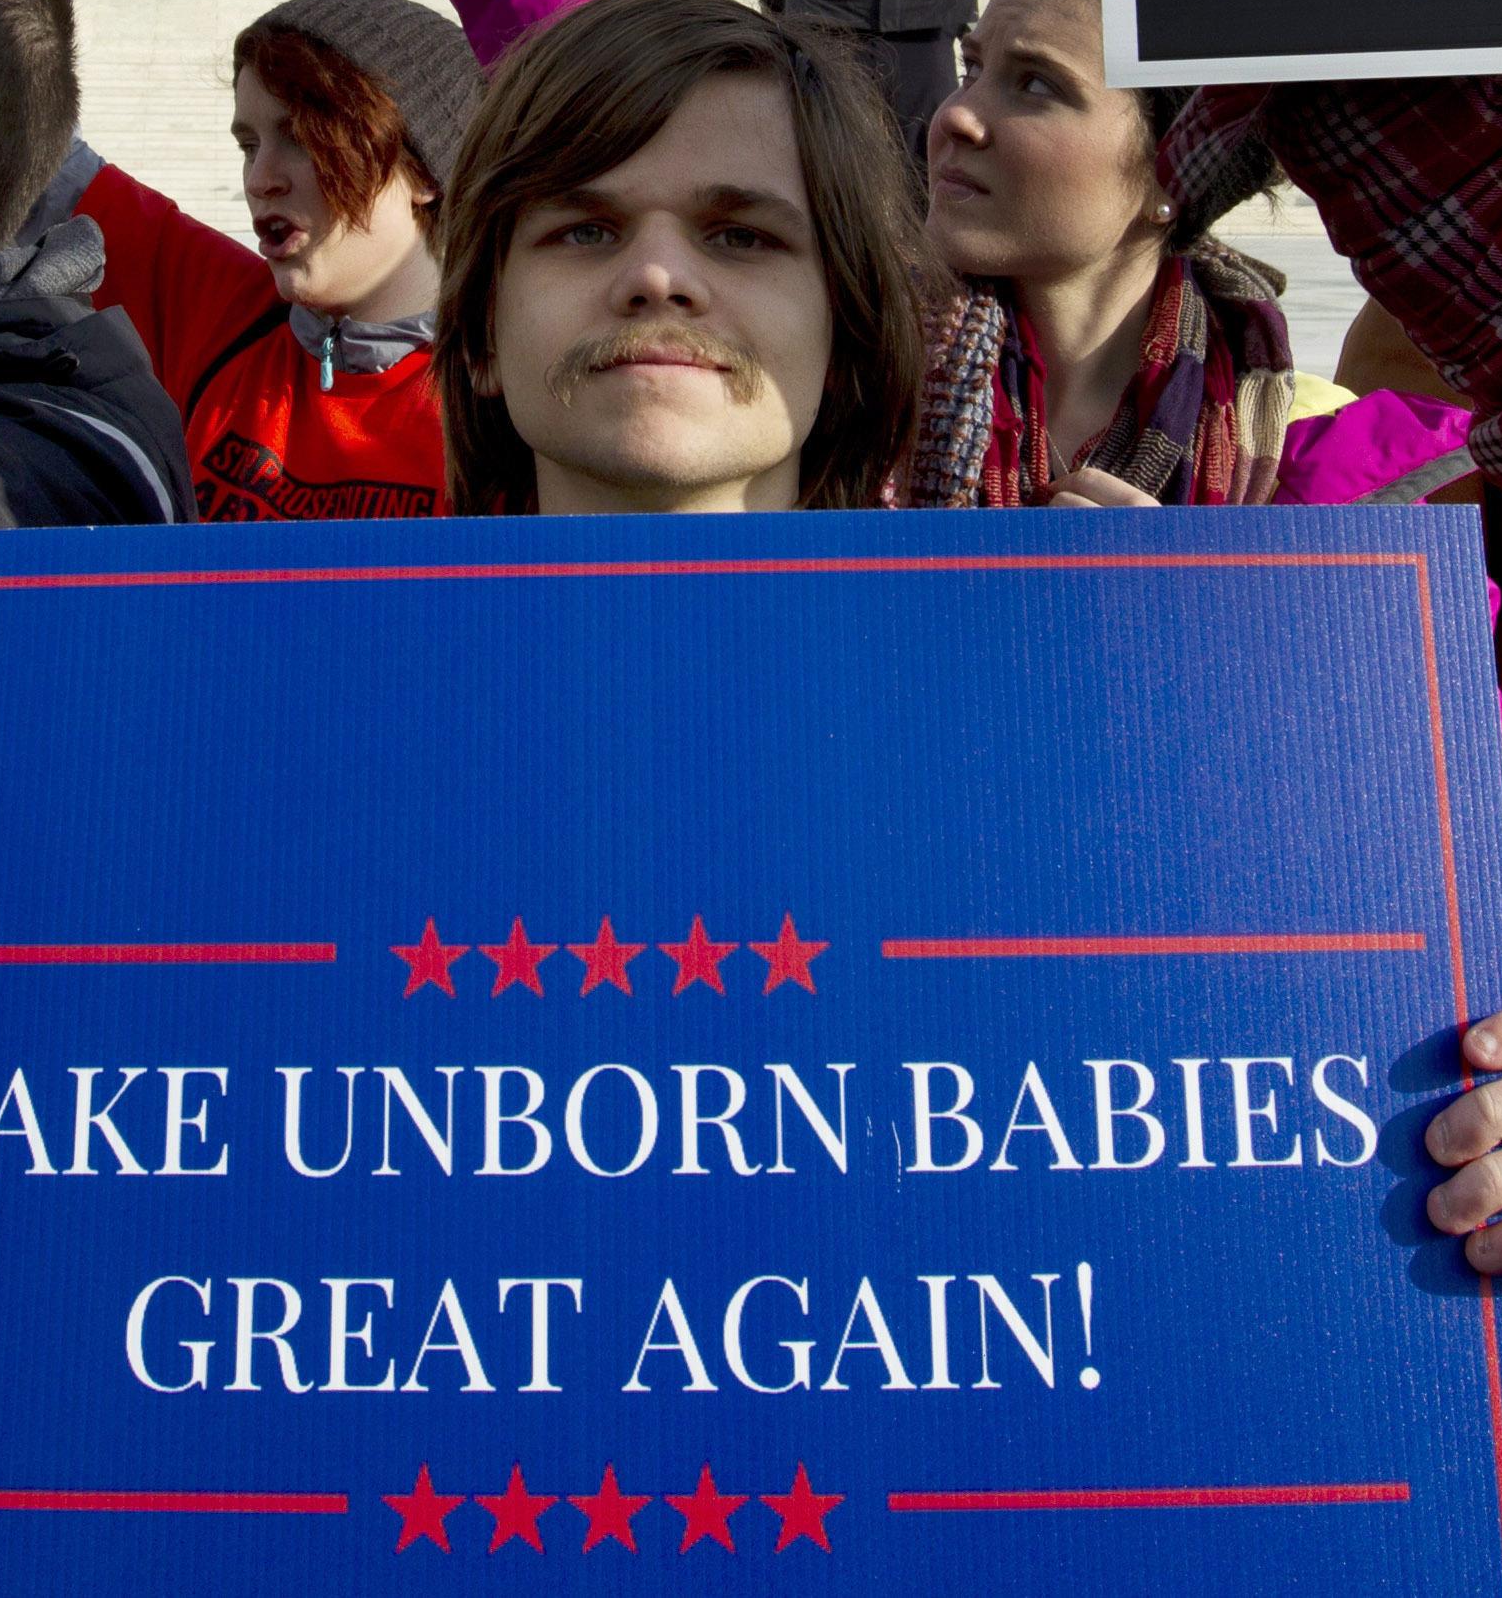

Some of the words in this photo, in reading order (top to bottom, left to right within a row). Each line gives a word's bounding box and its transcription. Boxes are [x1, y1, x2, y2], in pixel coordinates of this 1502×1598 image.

[274, 1063, 856, 1177] UNBORN
[902, 1054, 1379, 1173] BABIES
[125, 1275, 583, 1394] GREAT
[621, 1261, 1100, 1394] AGAIN!
